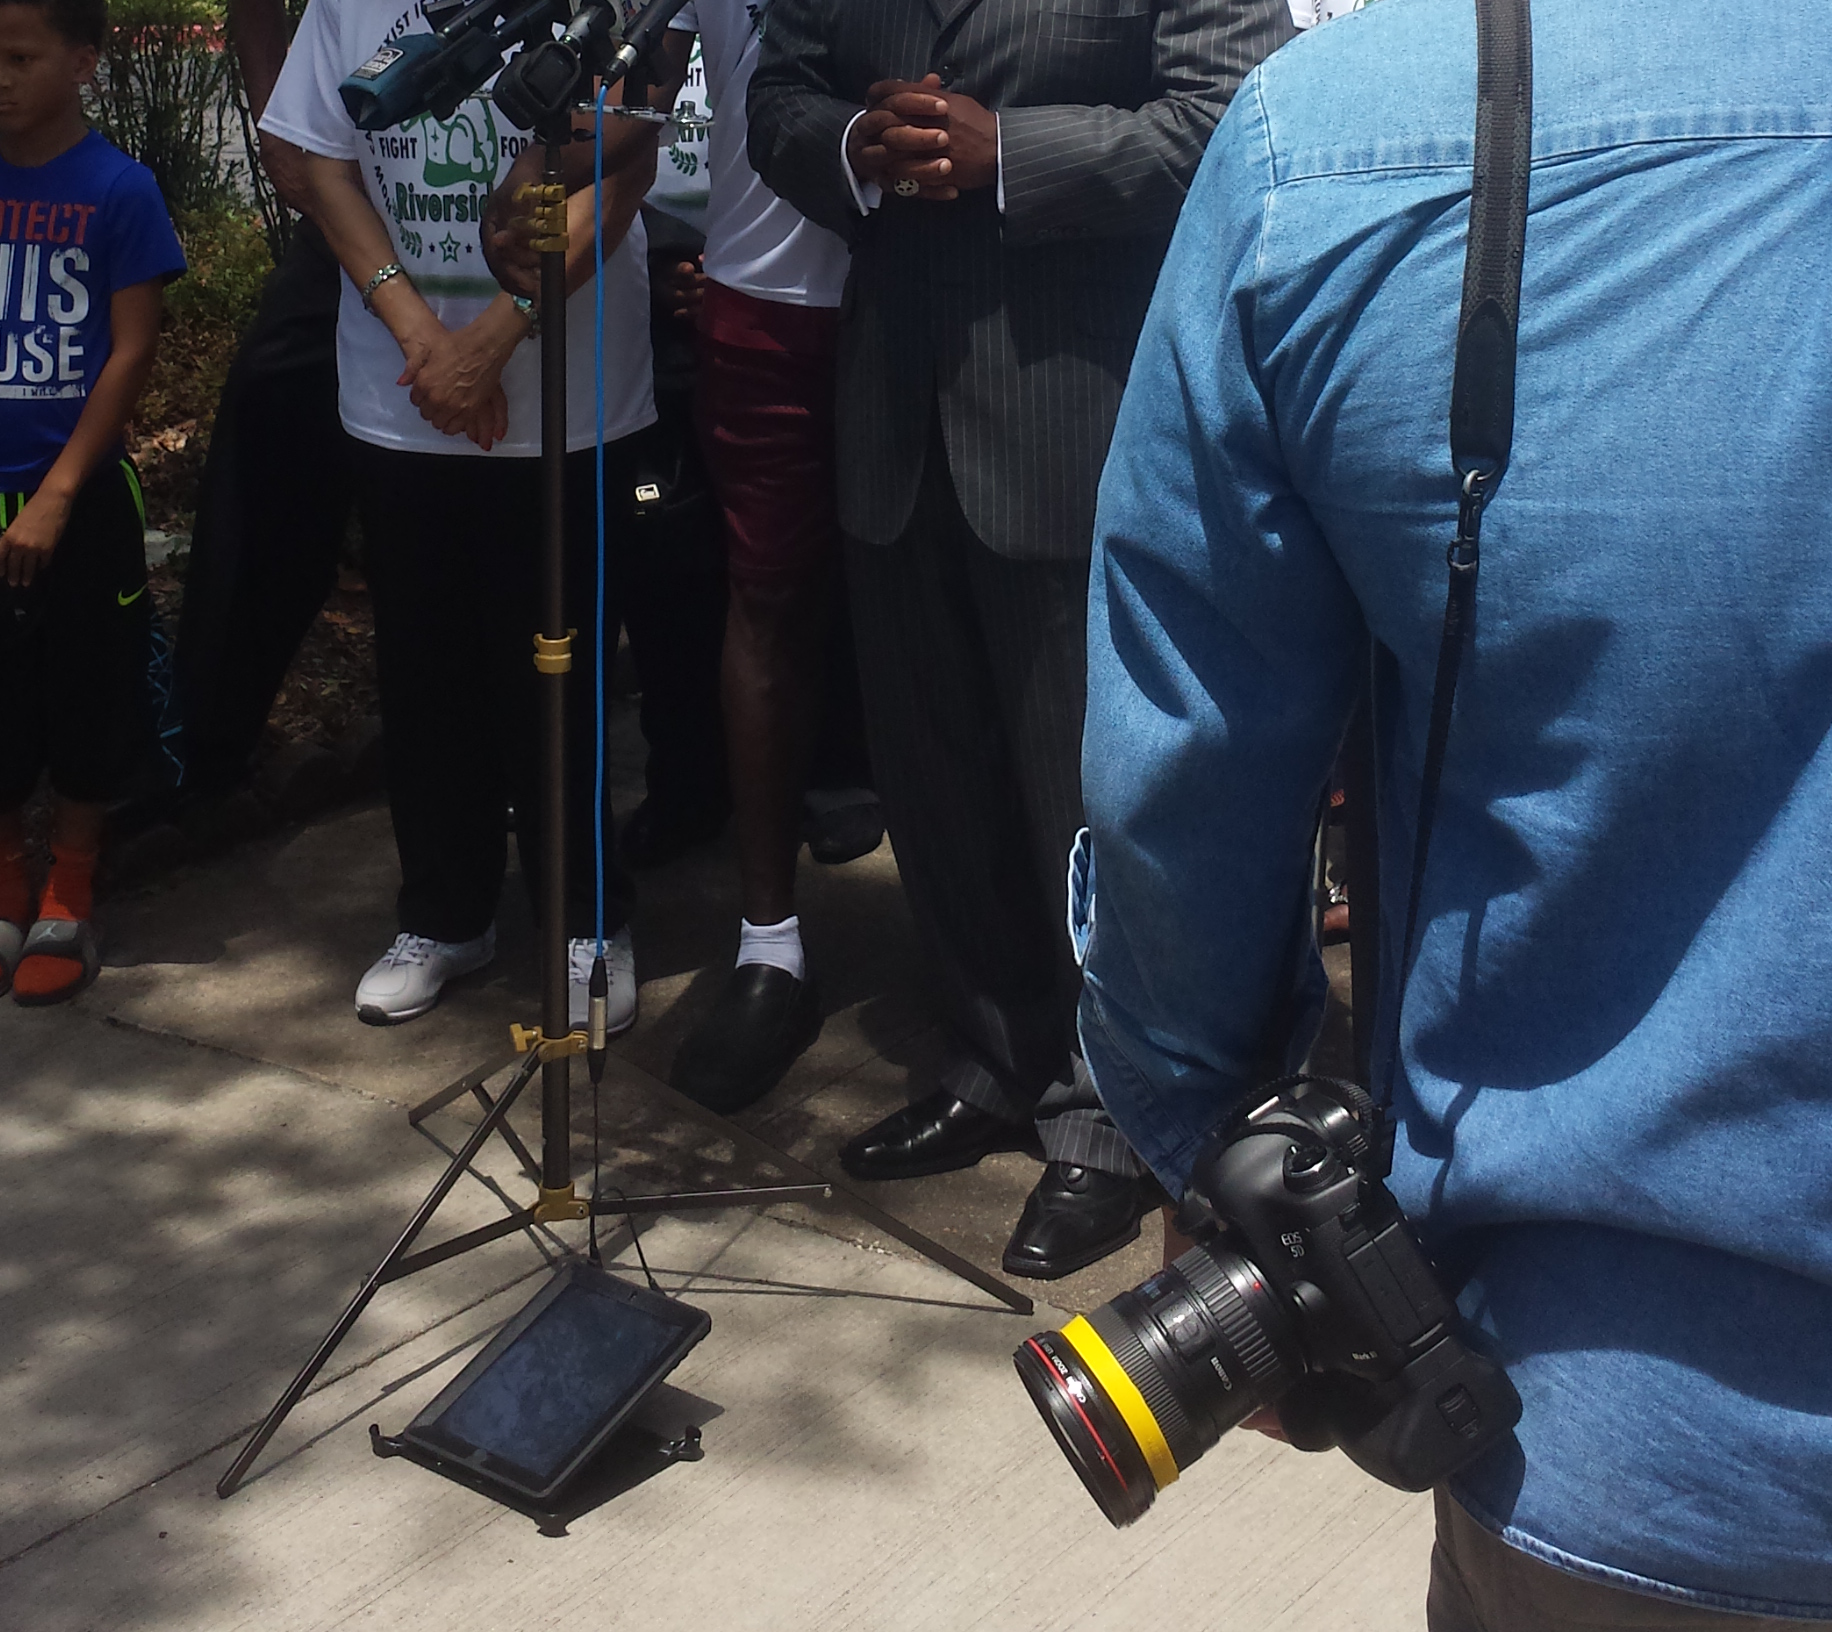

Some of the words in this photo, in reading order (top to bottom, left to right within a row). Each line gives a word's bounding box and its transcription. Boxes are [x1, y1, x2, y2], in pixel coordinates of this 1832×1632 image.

[379, 137, 418, 159] FIGHT
[0, 200, 96, 245] TECT
[1281, 1231, 1302, 1246] EOS
[1290, 1245, 1304, 1258] 5D
